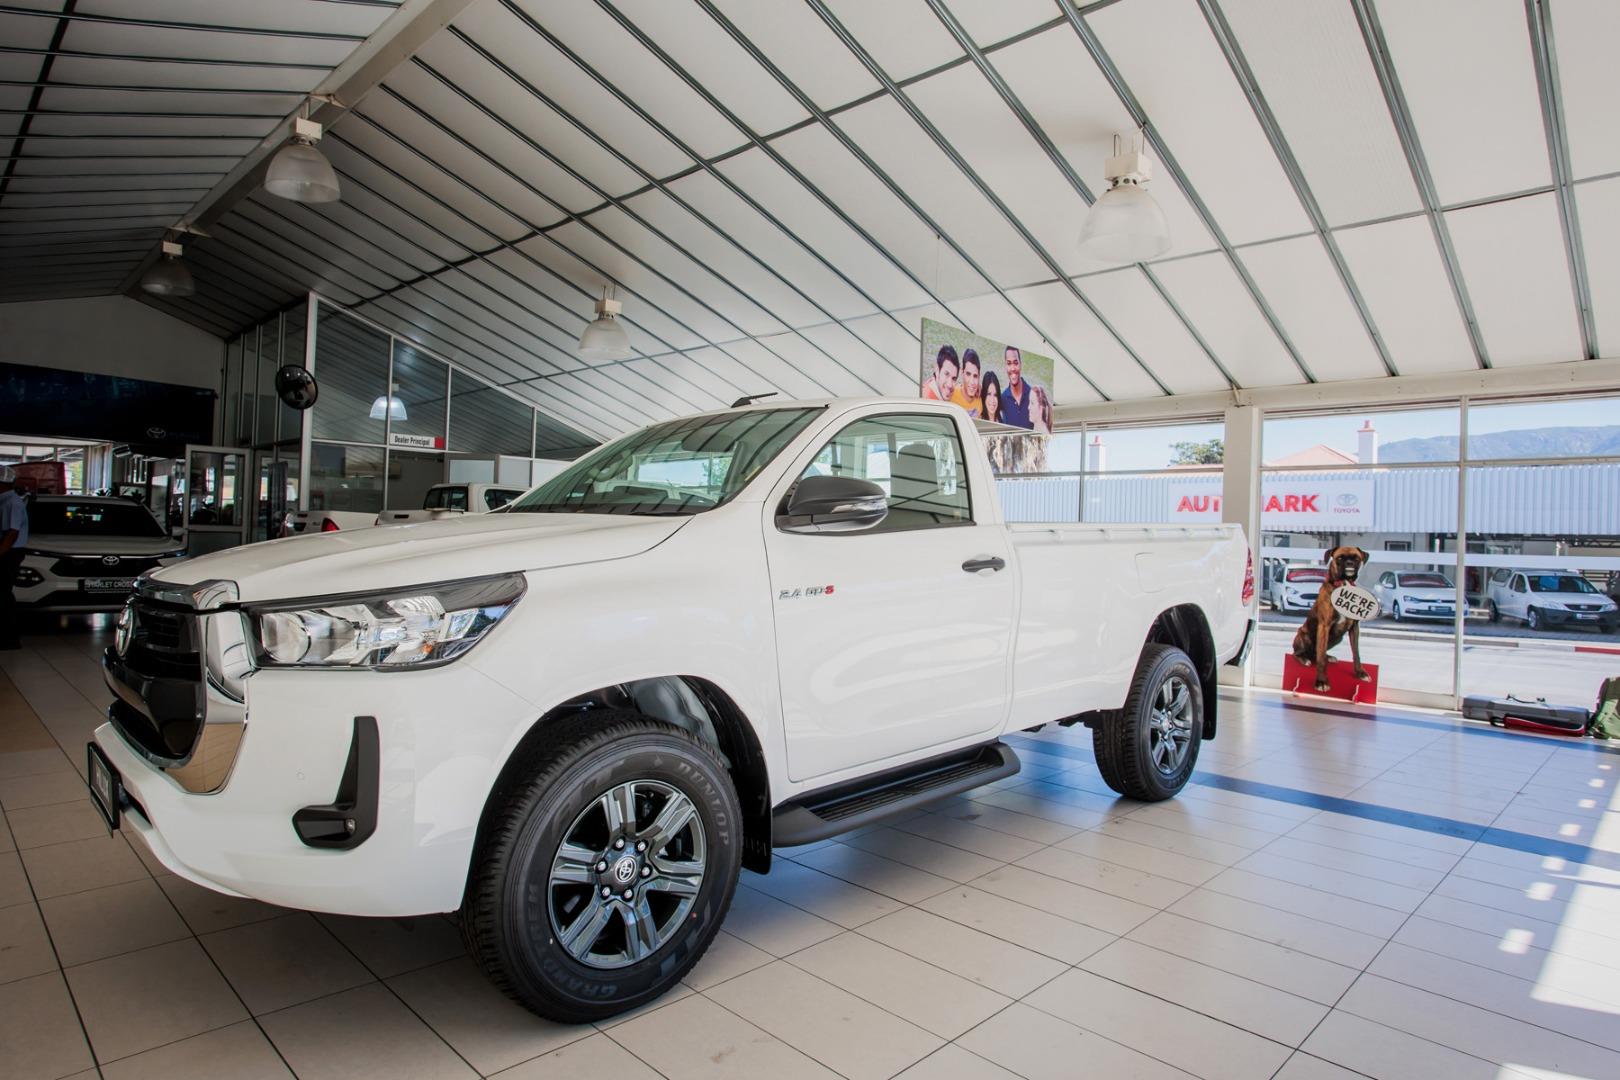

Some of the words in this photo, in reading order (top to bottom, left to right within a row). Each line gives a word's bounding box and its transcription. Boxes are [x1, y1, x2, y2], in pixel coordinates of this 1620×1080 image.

[1176, 495, 1320, 512] AUTARK
[1335, 597, 1369, 619] BACK!
[1340, 588, 1375, 611] WE'RE
[678, 761, 730, 847] DUNLOP
